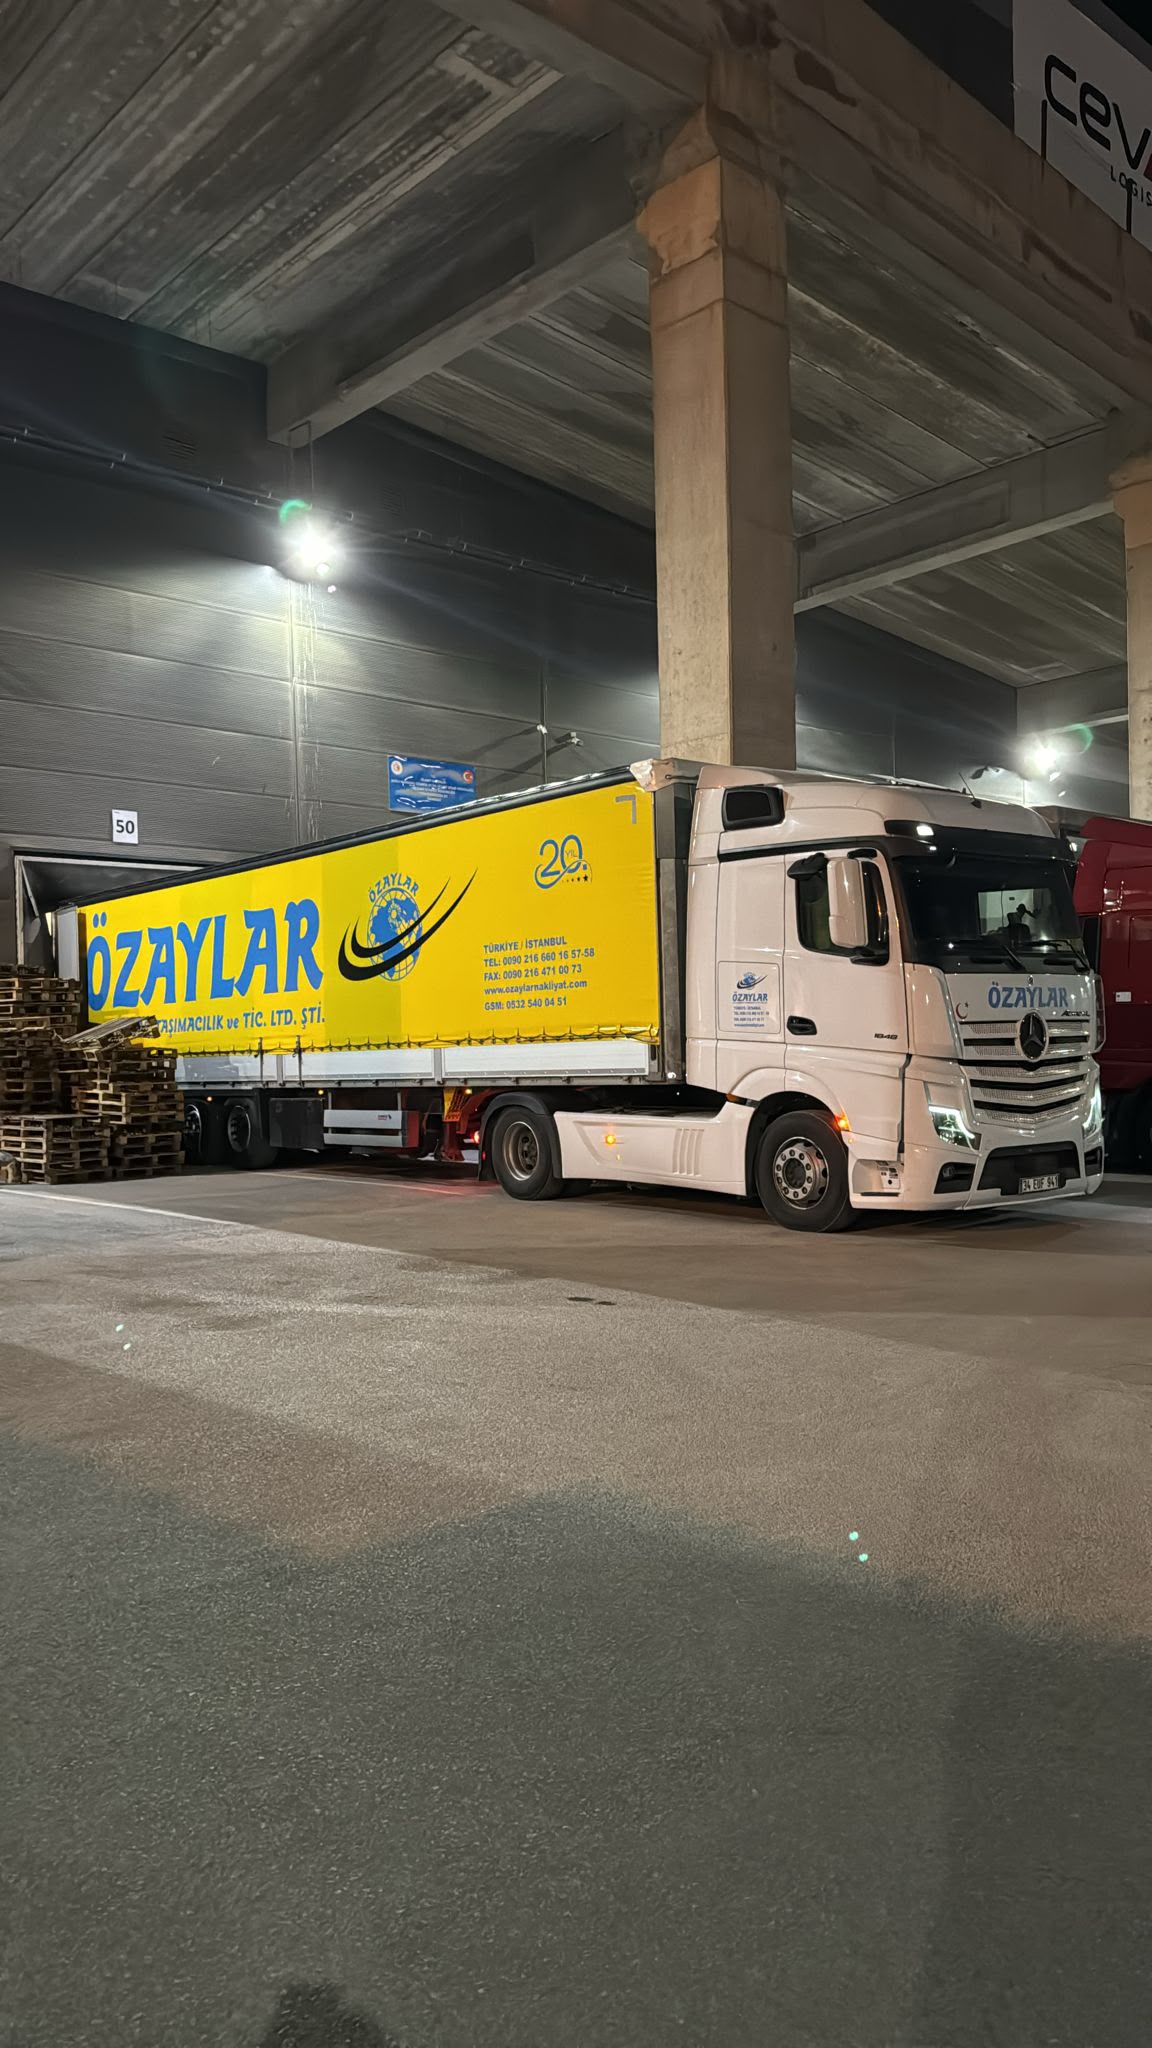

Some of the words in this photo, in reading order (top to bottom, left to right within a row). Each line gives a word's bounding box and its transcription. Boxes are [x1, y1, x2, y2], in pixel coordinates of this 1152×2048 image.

[116, 819, 135, 834] 50
[368, 872, 419, 903] ÖZAYLAR
[483, 941, 518, 954] TÜRKİYE
[525, 936, 567, 949] İSTANBUL
[87, 898, 324, 1011] ÖZAYLAR
[484, 958, 500, 967] TEL:
[503, 955, 522, 965] 0090
[524, 954, 539, 963] 216
[540, 952, 556, 961] 660
[559, 950, 568, 960] 16
[571, 948, 595, 958] 57-58
[484, 972, 501, 981] FAX:
[503, 969, 522, 979] 0090
[524, 968, 539, 977] 216
[541, 966, 556, 976] 471
[559, 965, 569, 974] 00
[572, 964, 582, 973] 73
[484, 980, 588, 995] www.ozaylarnakliyat.com
[988, 981, 1069, 1008] ÖZAYLAR
[484, 1001, 504, 1011] GSM:
[506, 999, 525, 1009] 0532
[528, 998, 542, 1008] 540
[545, 997, 555, 1007] 04
[557, 996, 567, 1006] 51
[732, 991, 768, 1002] ÖZAYLAR
[157, 1014, 224, 1038] TAŞIMACILIK
[226, 1018, 239, 1029] ve
[243, 1007, 266, 1028] TİC.
[270, 1009, 296, 1027] LTD.
[301, 1001, 325, 1030] ŞTİ.
[1023, 1180, 1031, 1191] 34
